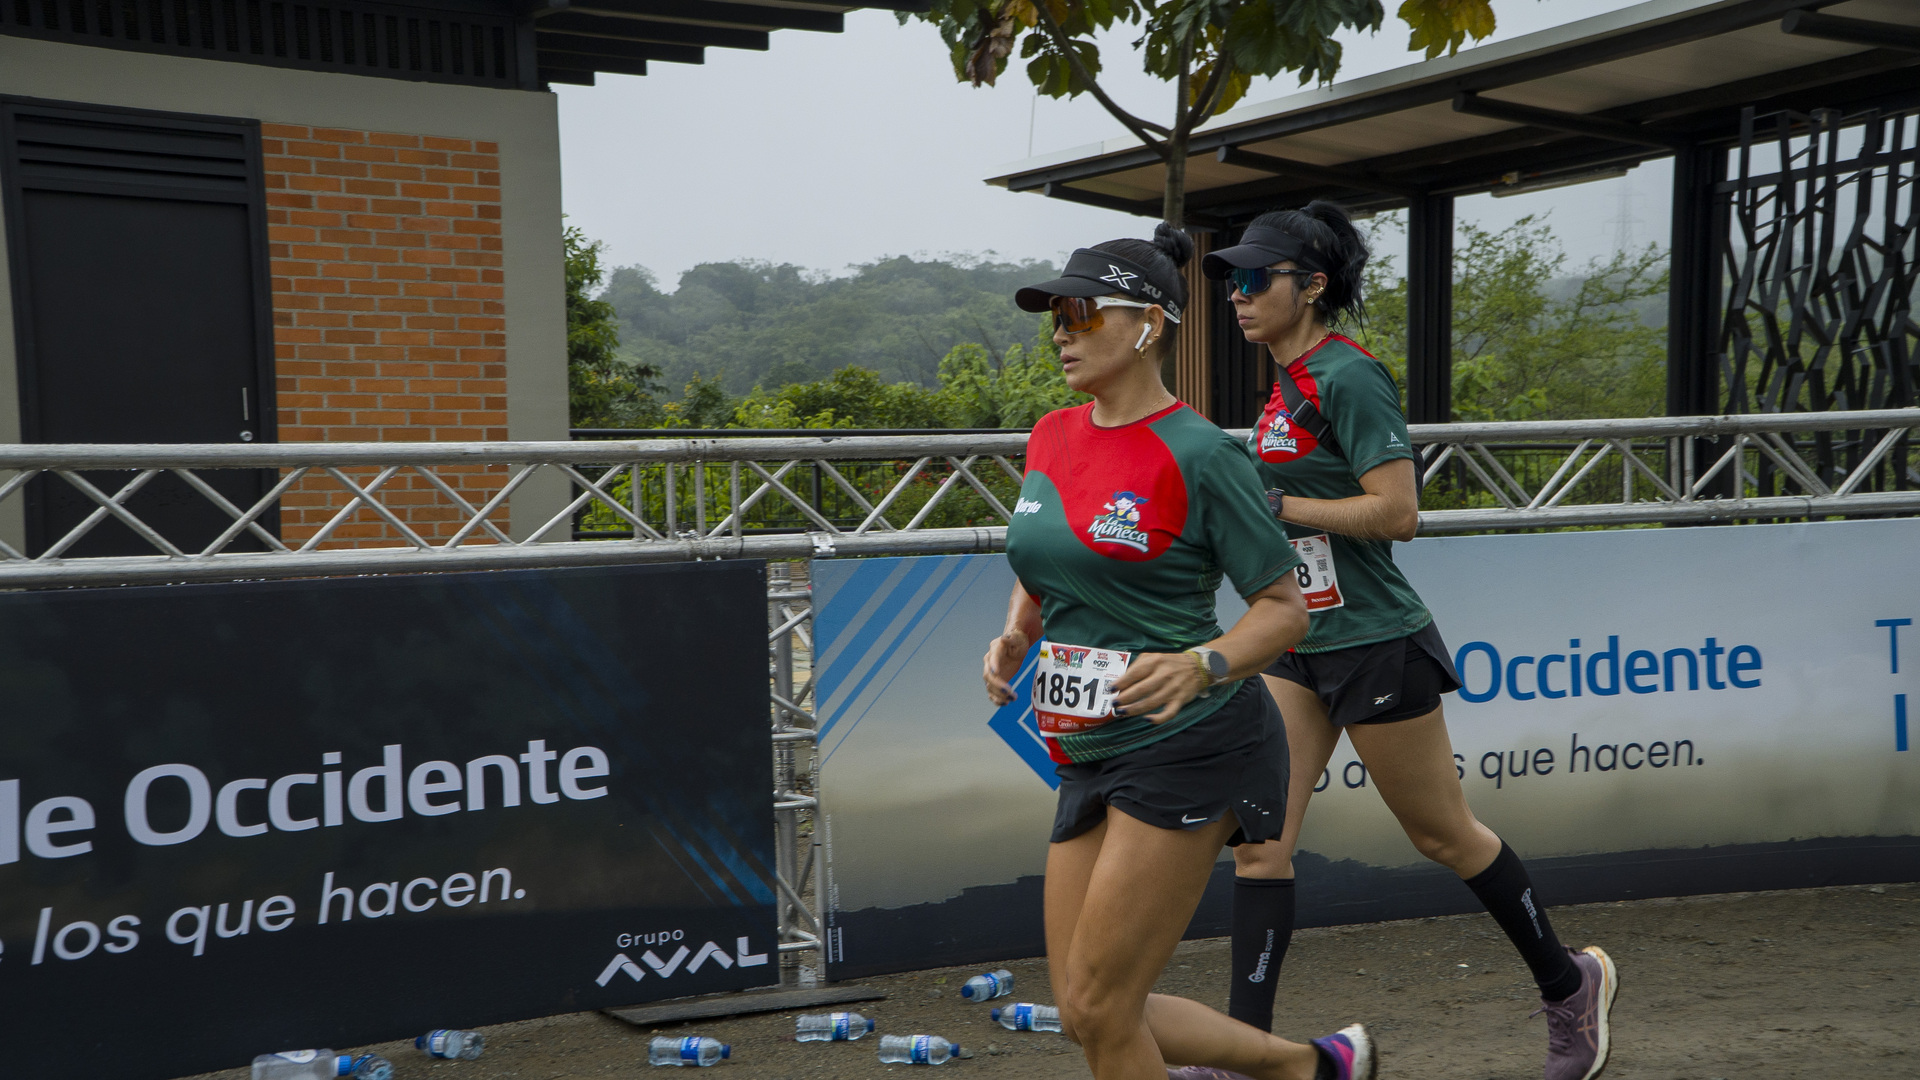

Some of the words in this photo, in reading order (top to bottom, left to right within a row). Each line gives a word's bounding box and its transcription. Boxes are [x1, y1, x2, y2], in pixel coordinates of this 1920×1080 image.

[1087, 519, 1149, 544] Muñeca
[1093, 659, 1110, 668] eggy
[1455, 635, 1762, 703] Occidente
[1874, 618, 1913, 674] T
[1036, 671, 1100, 711] 1851
[1480, 747, 1555, 789] que
[1569, 733, 1704, 774] hacen.
[124, 739, 610, 846] Occidente
[31, 906, 142, 966] los
[165, 894, 296, 957] que
[318, 867, 526, 925] hacen.
[616, 929, 685, 948] Grupo
[595, 936, 769, 988] AVAL
